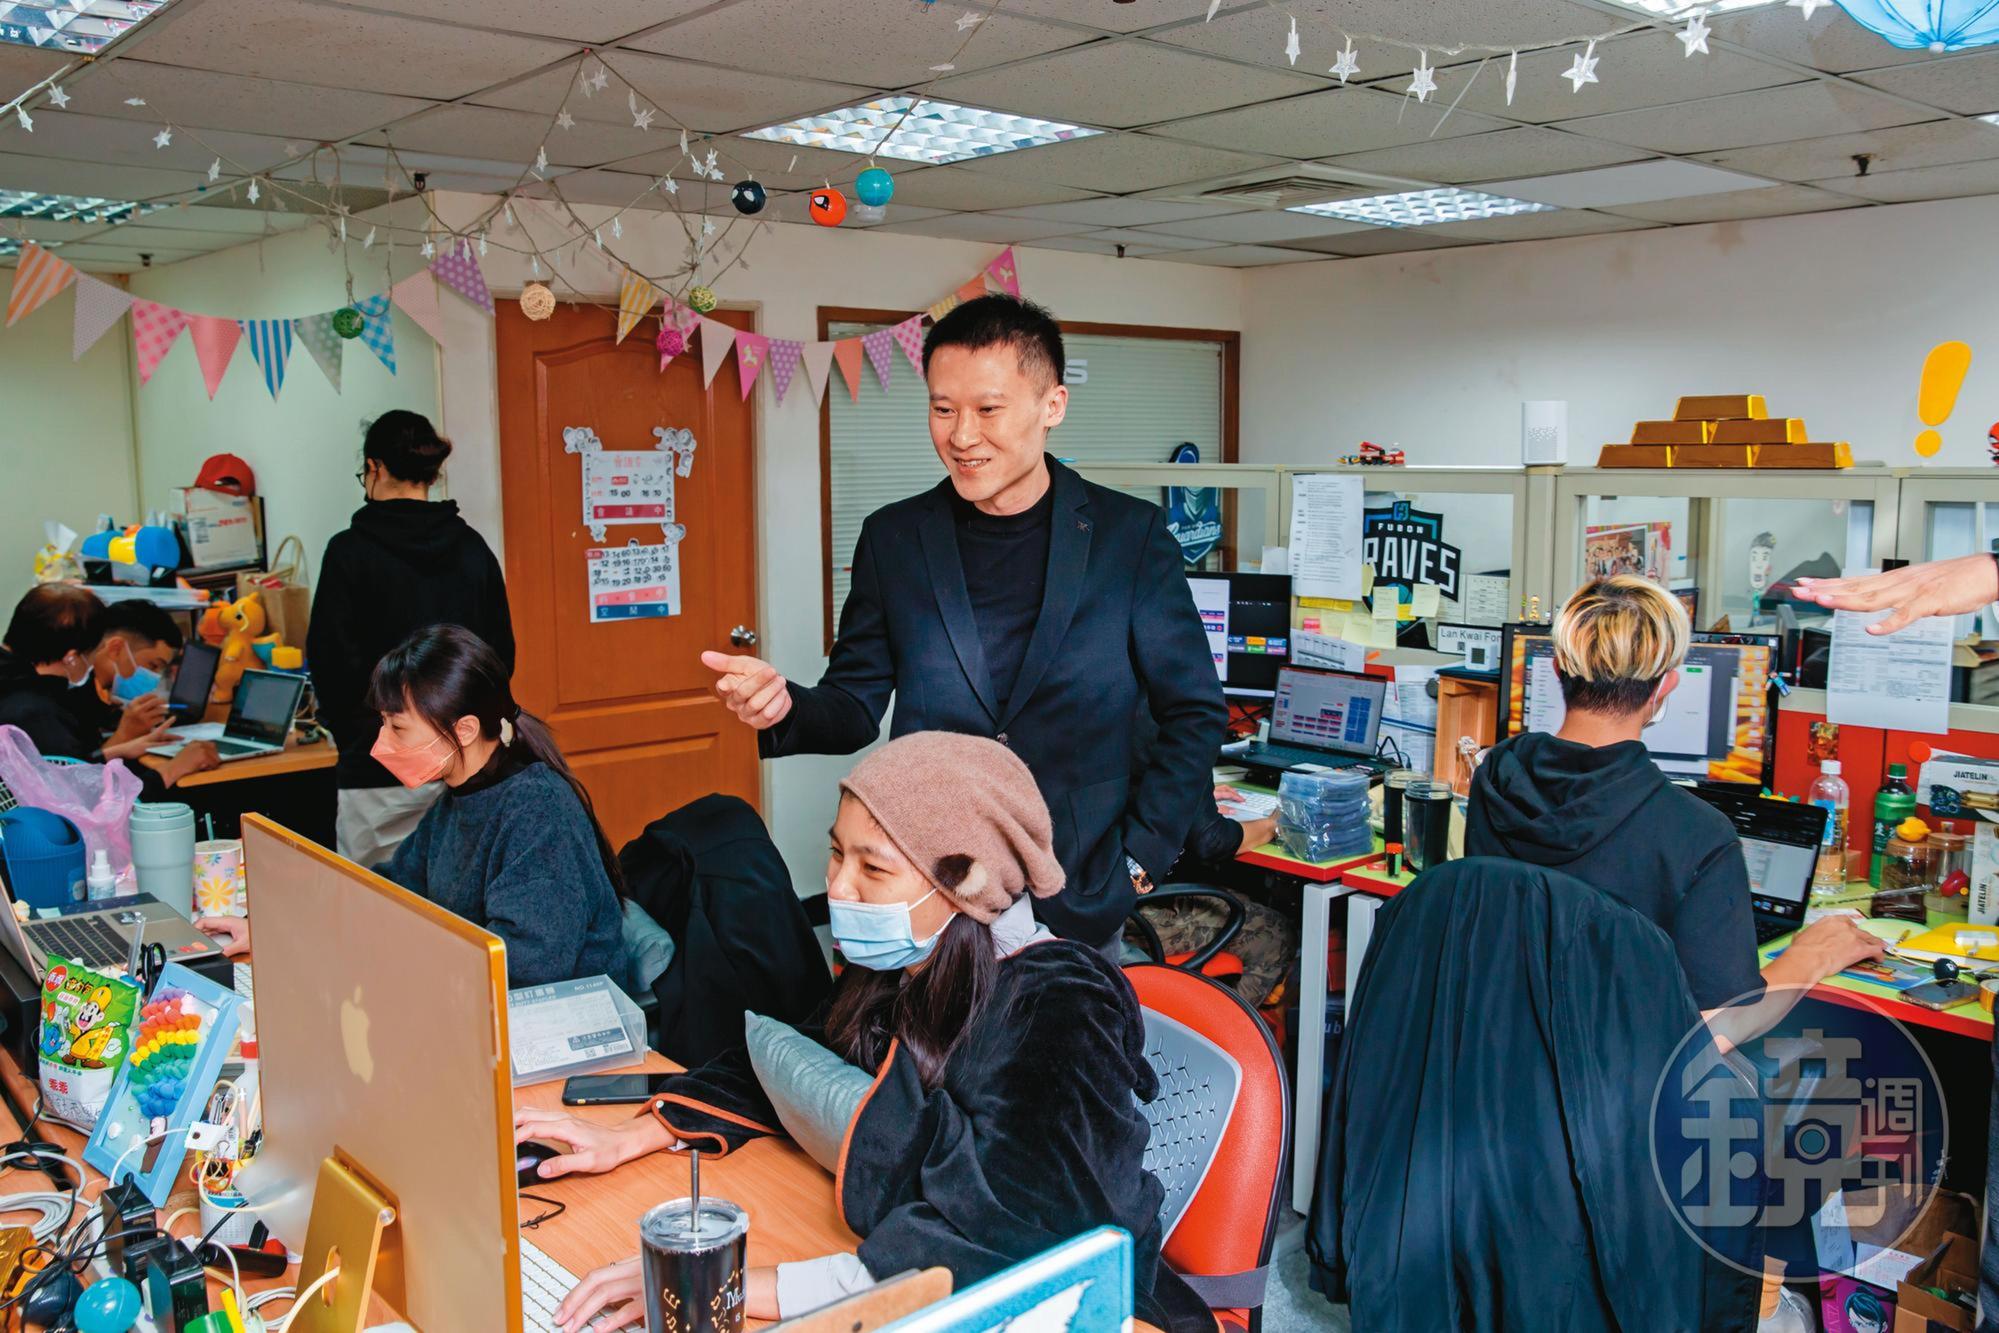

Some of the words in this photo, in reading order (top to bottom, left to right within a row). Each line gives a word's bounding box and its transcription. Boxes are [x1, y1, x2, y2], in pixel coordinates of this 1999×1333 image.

[1378, 522, 1424, 534] FUBON
[1363, 537, 1457, 594] RAVES
[1441, 628, 1457, 639] Lan
[1460, 630, 1482, 641] Kwai
[1953, 771, 1988, 781] JIATELIN
[1976, 883, 1987, 915] JIATELIN
